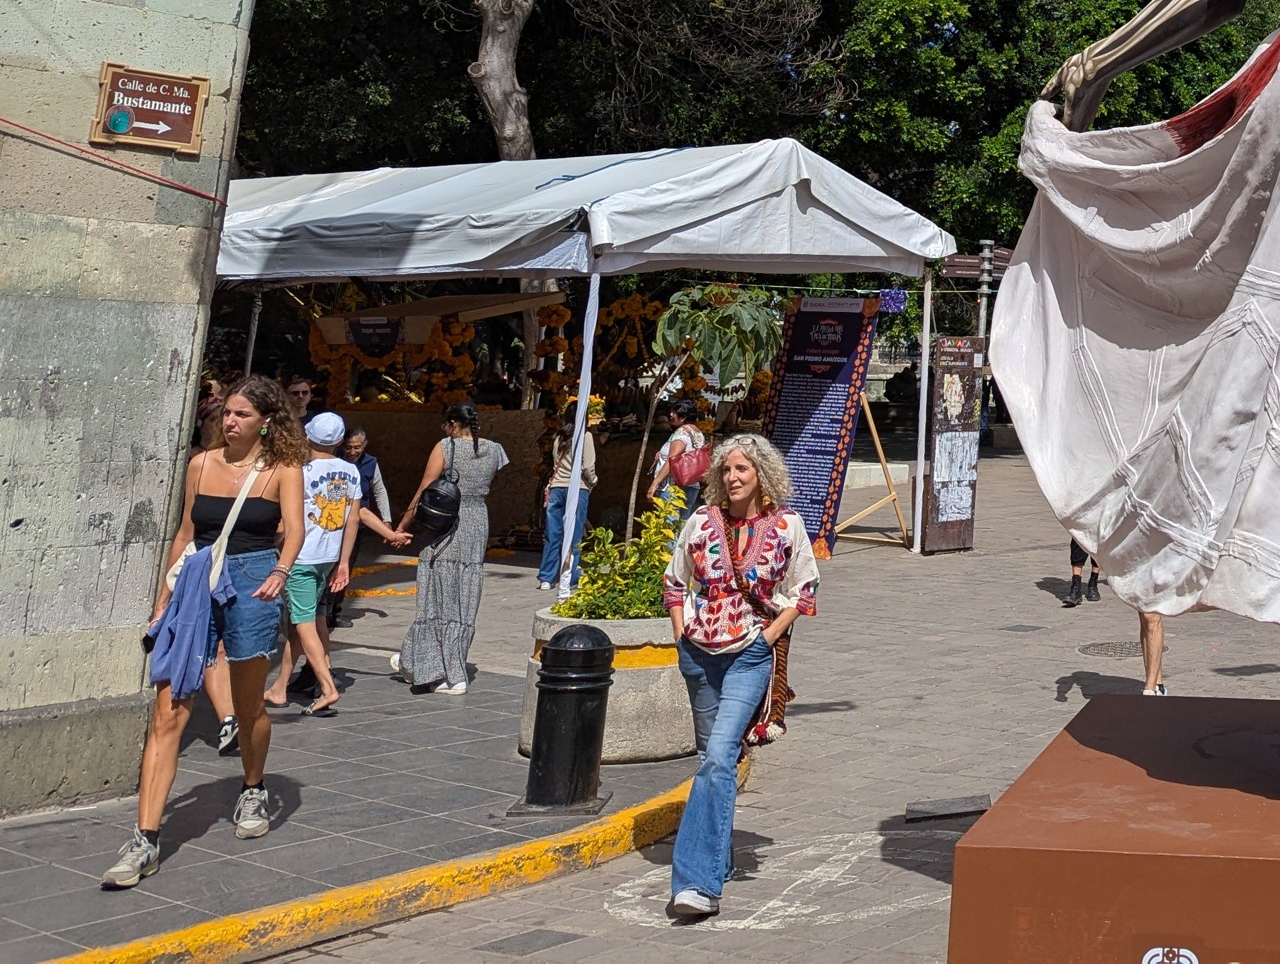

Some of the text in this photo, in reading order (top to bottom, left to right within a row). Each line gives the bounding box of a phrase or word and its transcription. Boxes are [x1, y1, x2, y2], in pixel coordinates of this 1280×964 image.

[118, 78, 191, 98] Calle de C. Ma.
[112, 91, 192, 115] Bustamante
